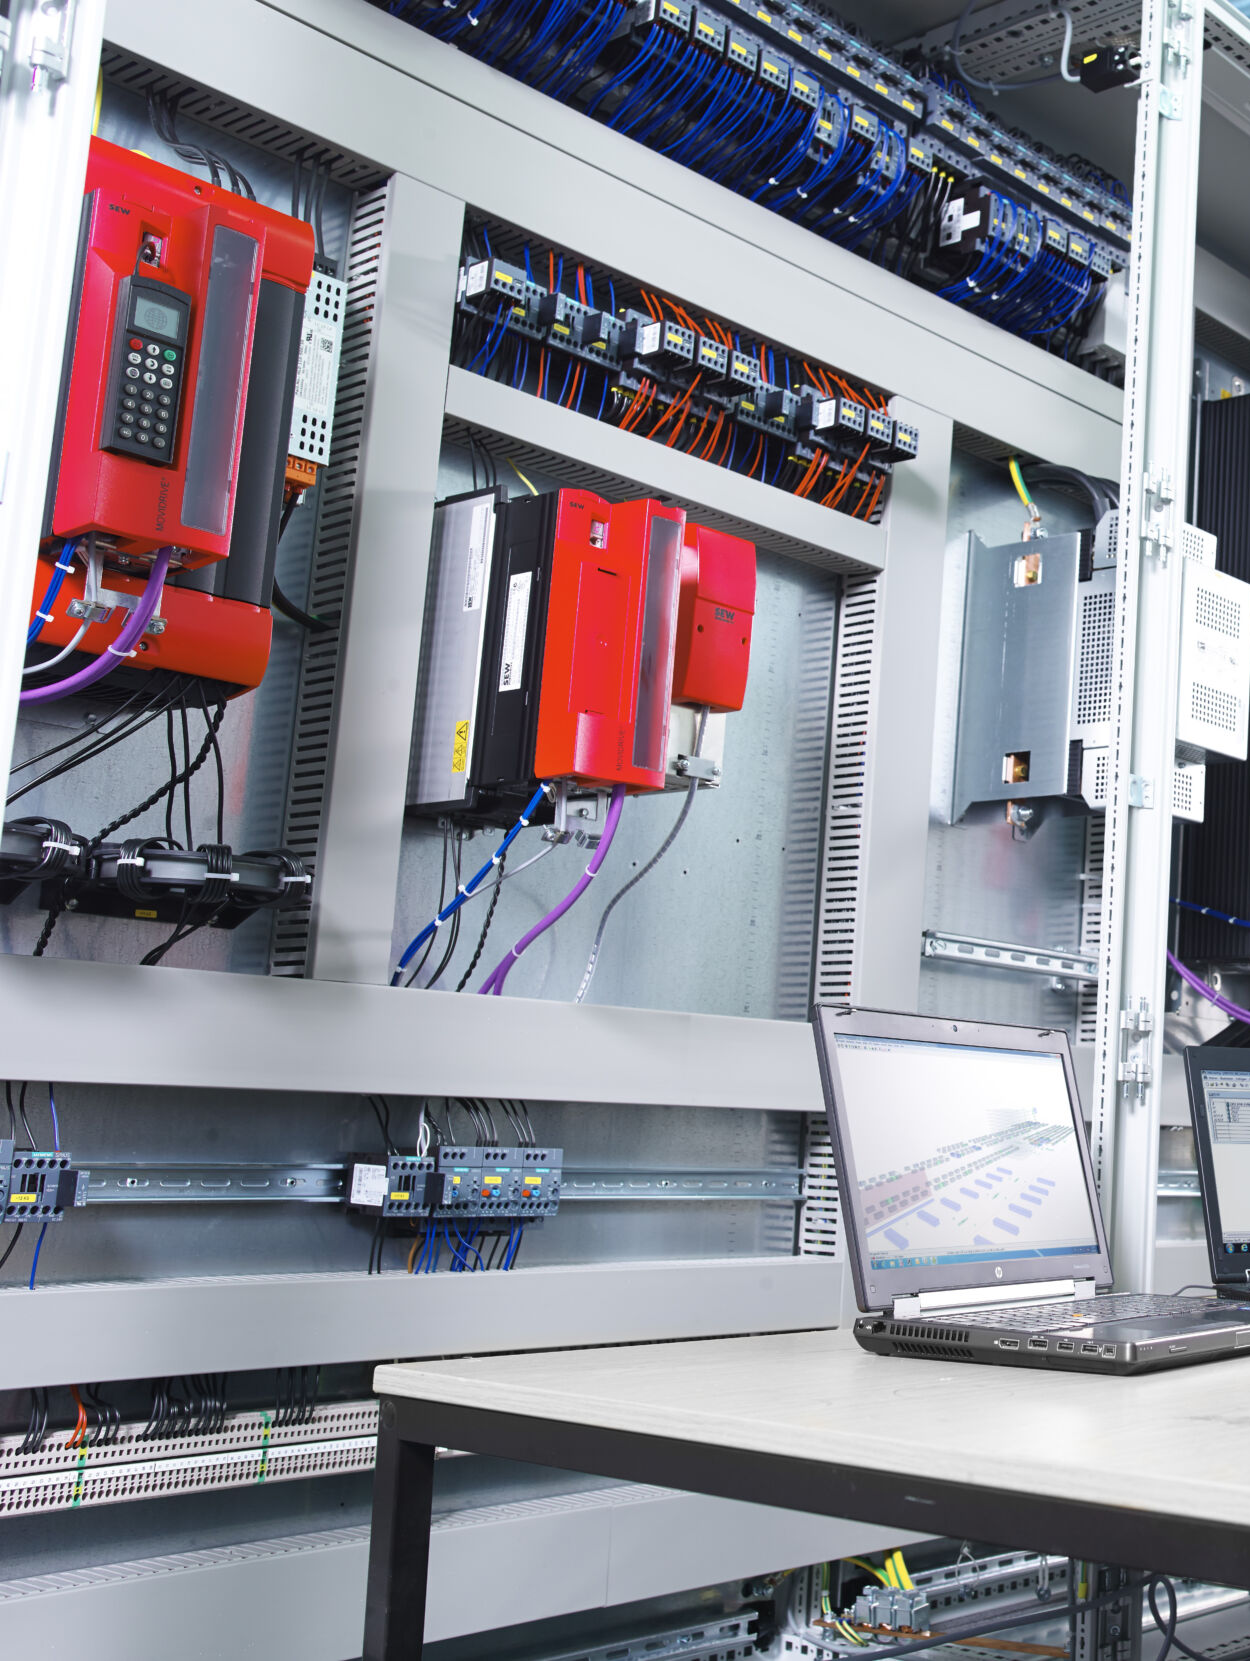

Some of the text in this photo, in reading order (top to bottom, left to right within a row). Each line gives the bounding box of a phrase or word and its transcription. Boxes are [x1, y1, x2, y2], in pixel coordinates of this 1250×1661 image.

[108, 203, 131, 215] SEW
[569, 501, 585, 511] SEW
[714, 608, 735, 620] SEW
